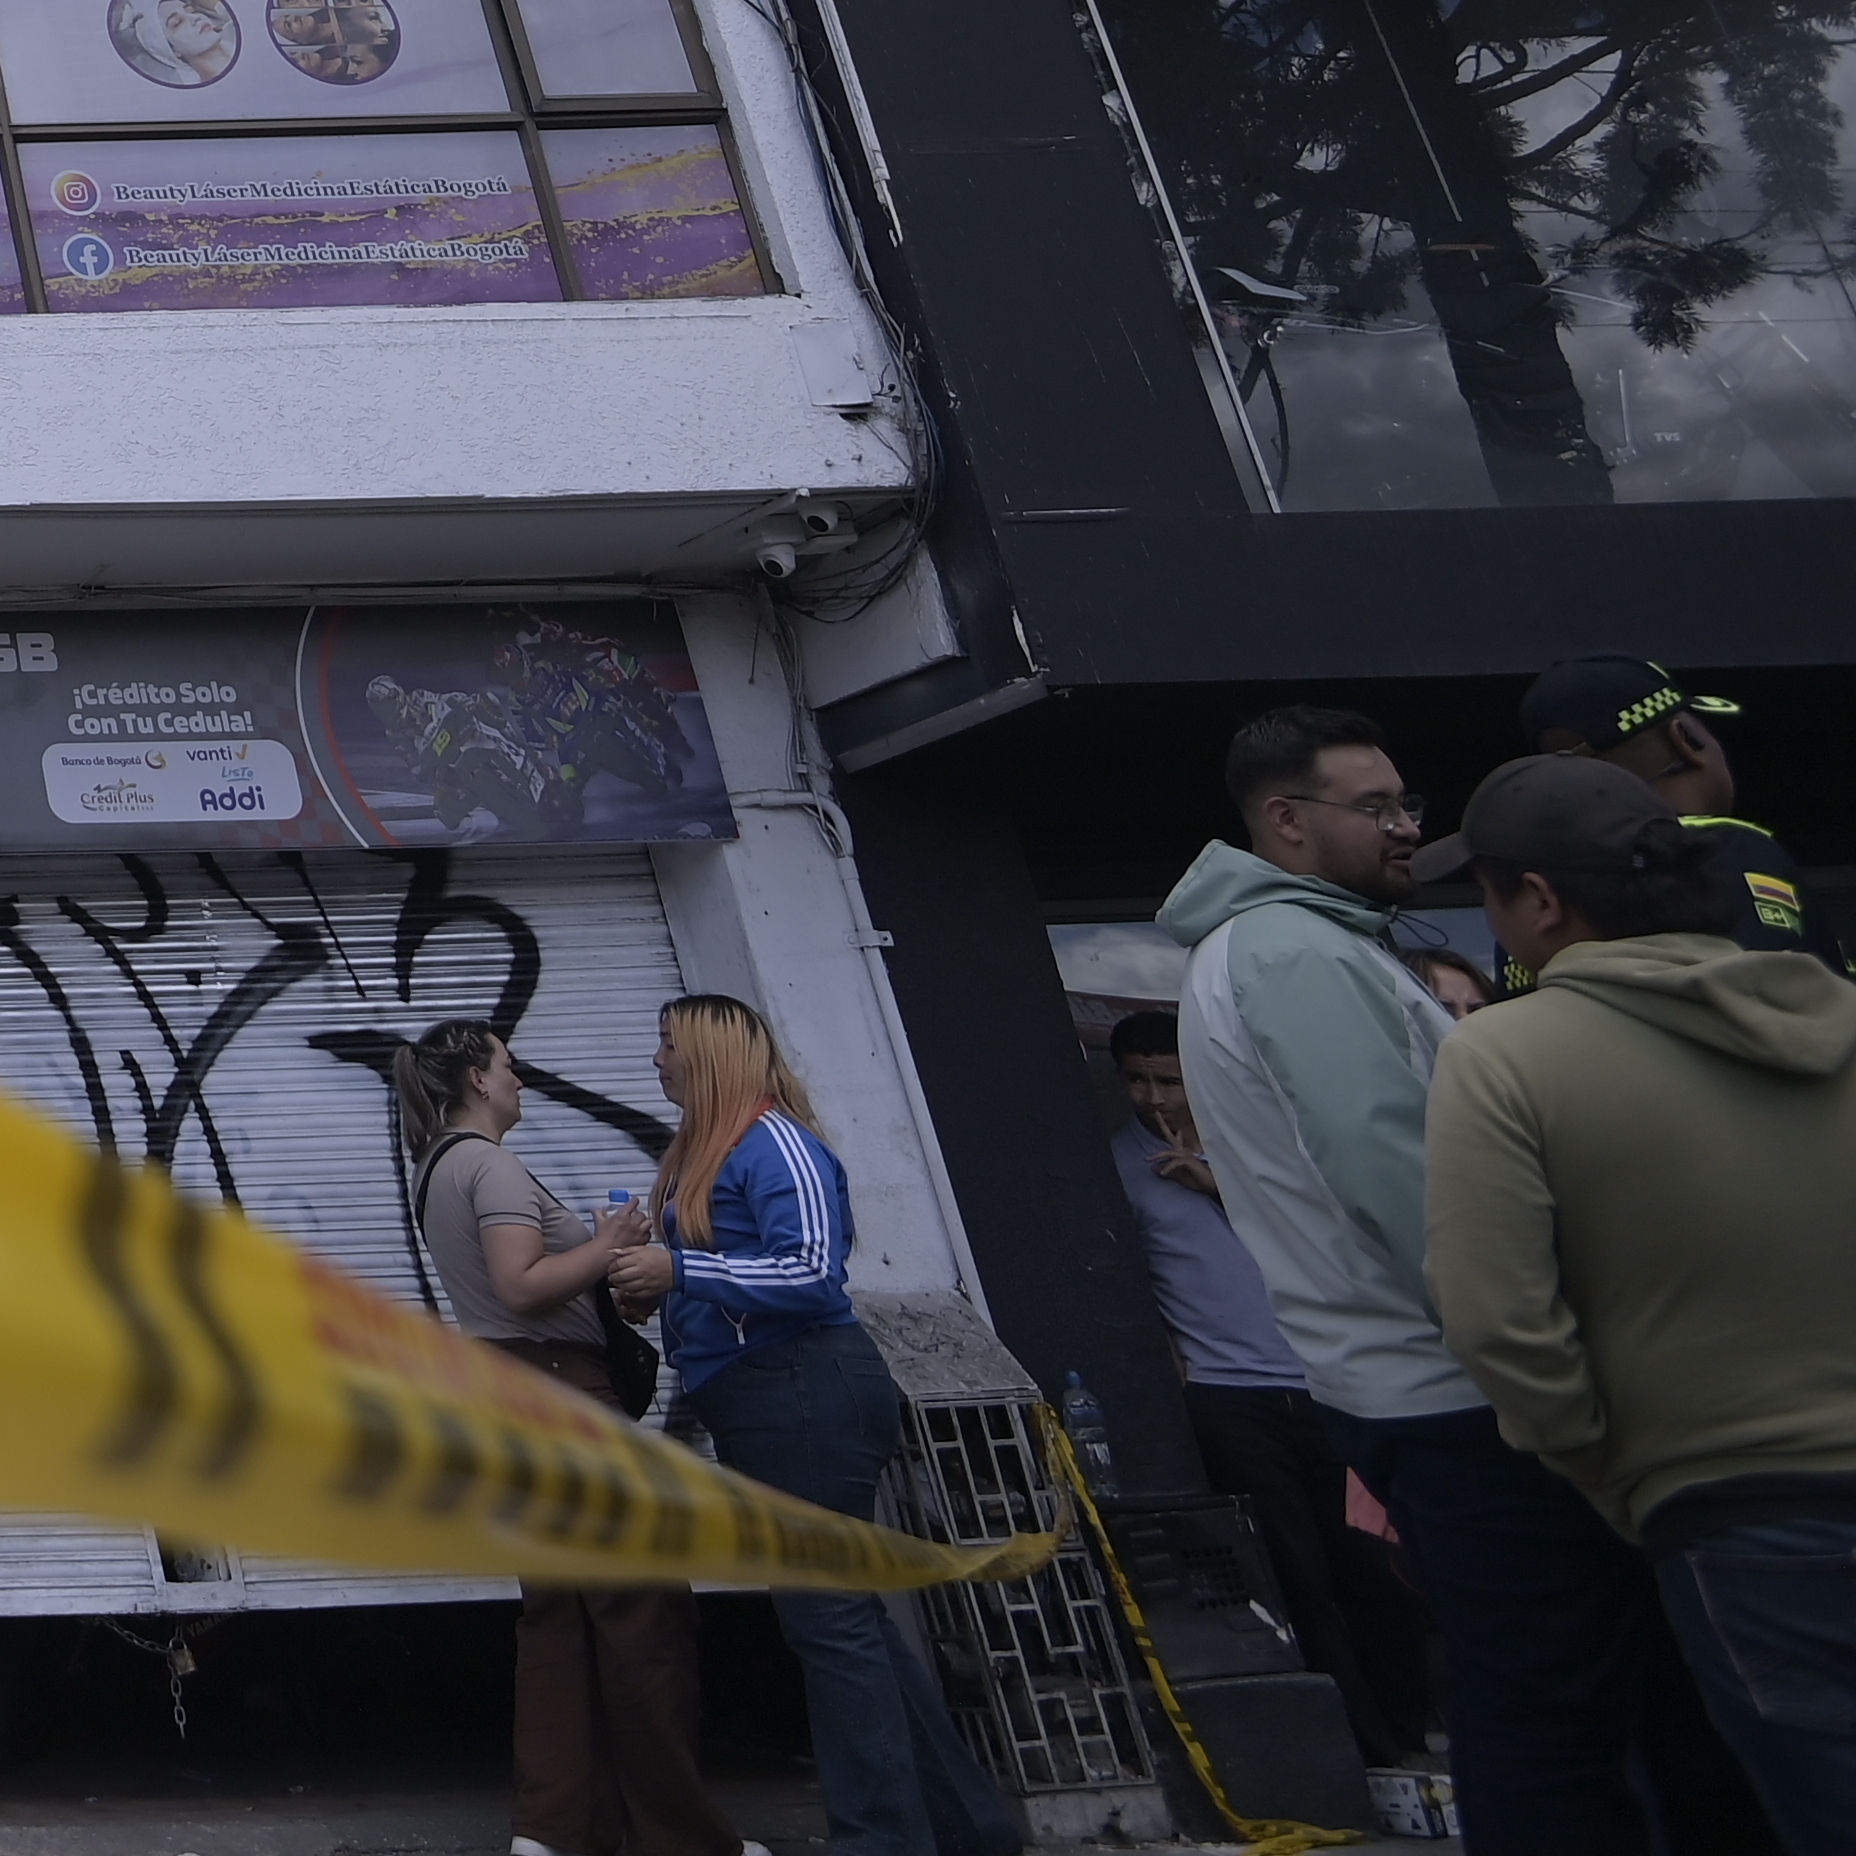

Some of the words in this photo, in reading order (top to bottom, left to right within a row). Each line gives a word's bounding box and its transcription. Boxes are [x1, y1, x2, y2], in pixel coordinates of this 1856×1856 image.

[114, 175, 509, 203] BeautyLáserMedicinaEstáticaBogotá
[127, 241, 525, 266] BeautyLáserMedicinaEstáticaBogotá
[73, 681, 176, 708] ¡Crédito
[180, 681, 236, 704] Solo
[68, 713, 118, 736] Con
[122, 712, 153, 735] Tu
[157, 710, 253, 734] Cedula!
[61, 757, 91, 766] Banco
[93, 757, 105, 766] de
[107, 756, 141, 767] Bogotá
[186, 745, 232, 761] vanti
[200, 786, 265, 811] Addi
